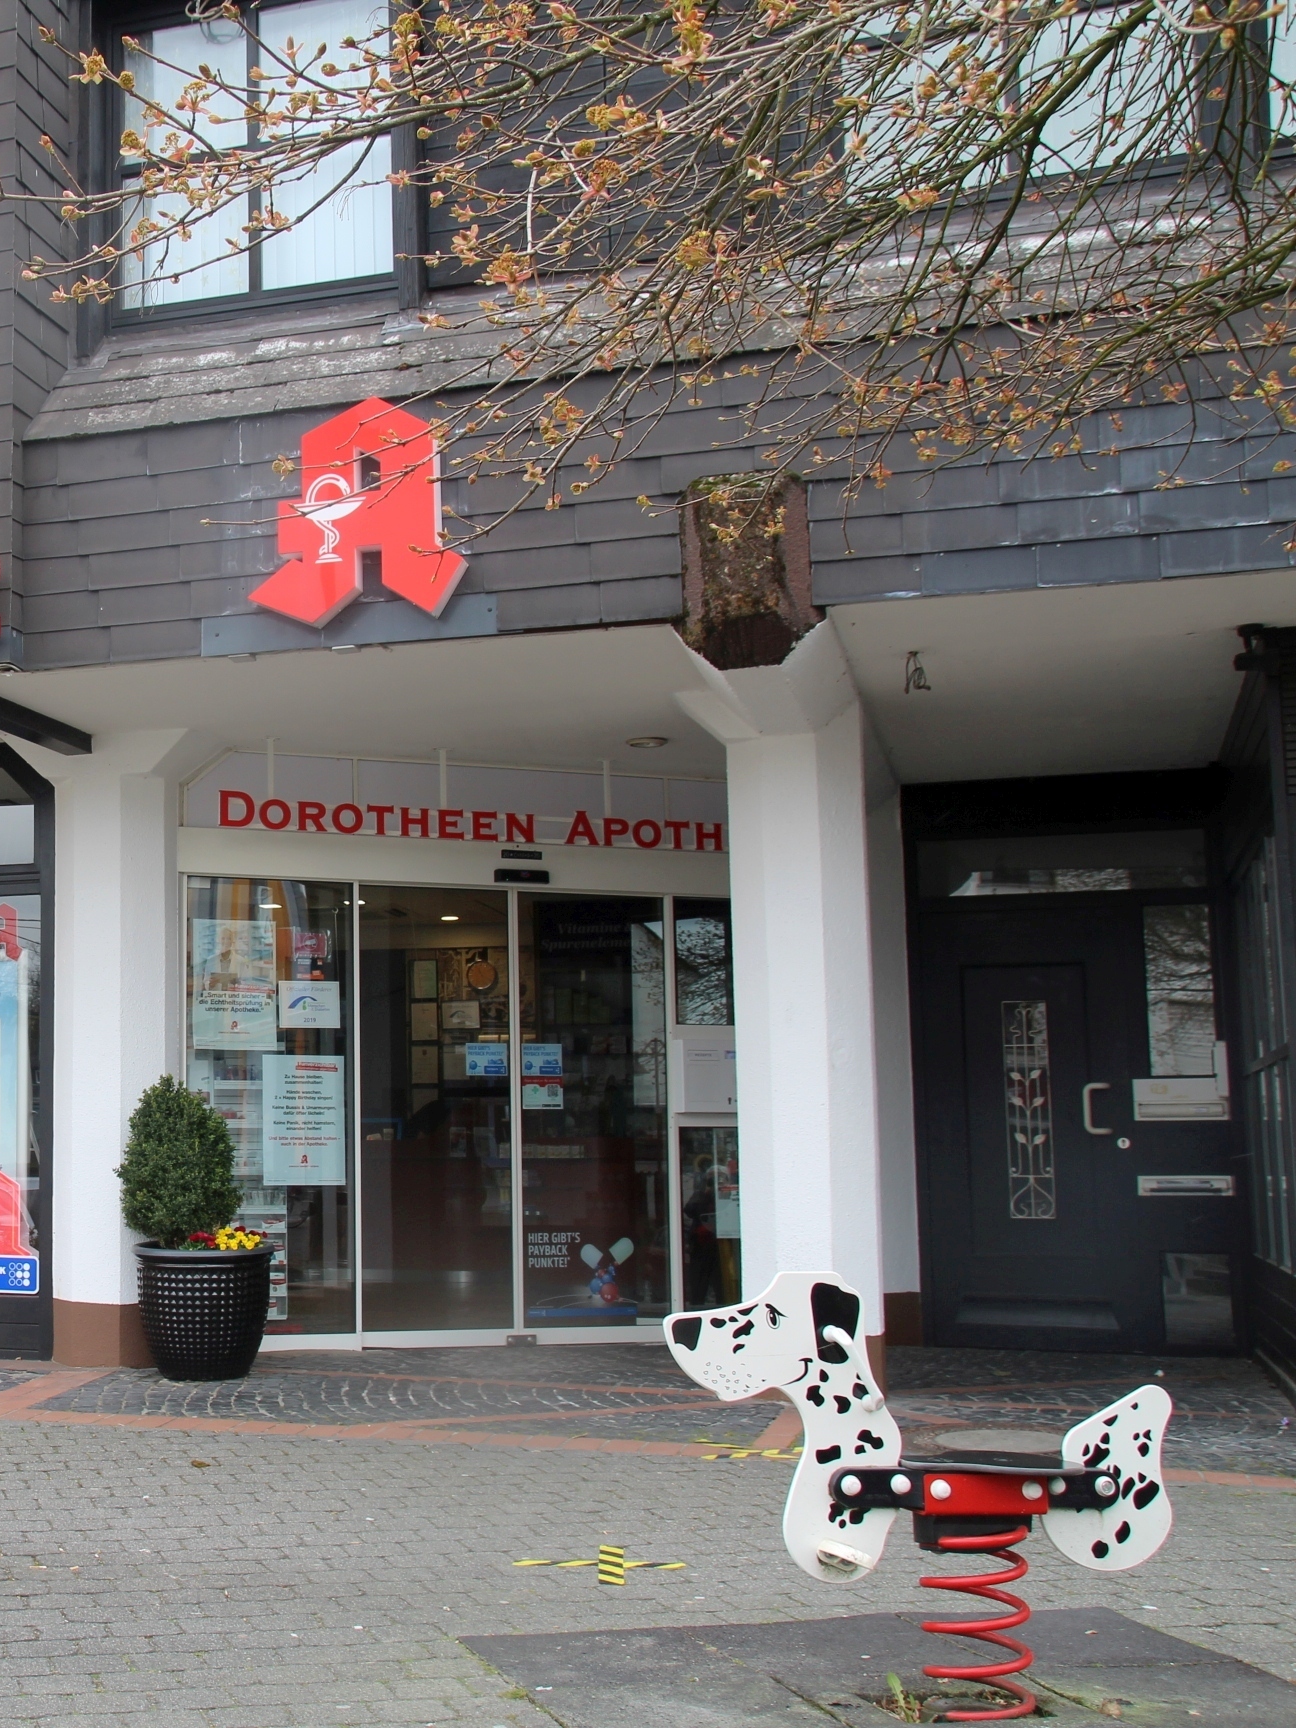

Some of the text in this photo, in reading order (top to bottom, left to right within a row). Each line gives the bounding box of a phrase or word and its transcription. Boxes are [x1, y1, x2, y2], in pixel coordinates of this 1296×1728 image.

[218, 789, 723, 851] DOROTHEEN APOTH
[528, 1232, 581, 1243] HIER GIBT'S
[528, 1245, 568, 1256] PAYBACK
